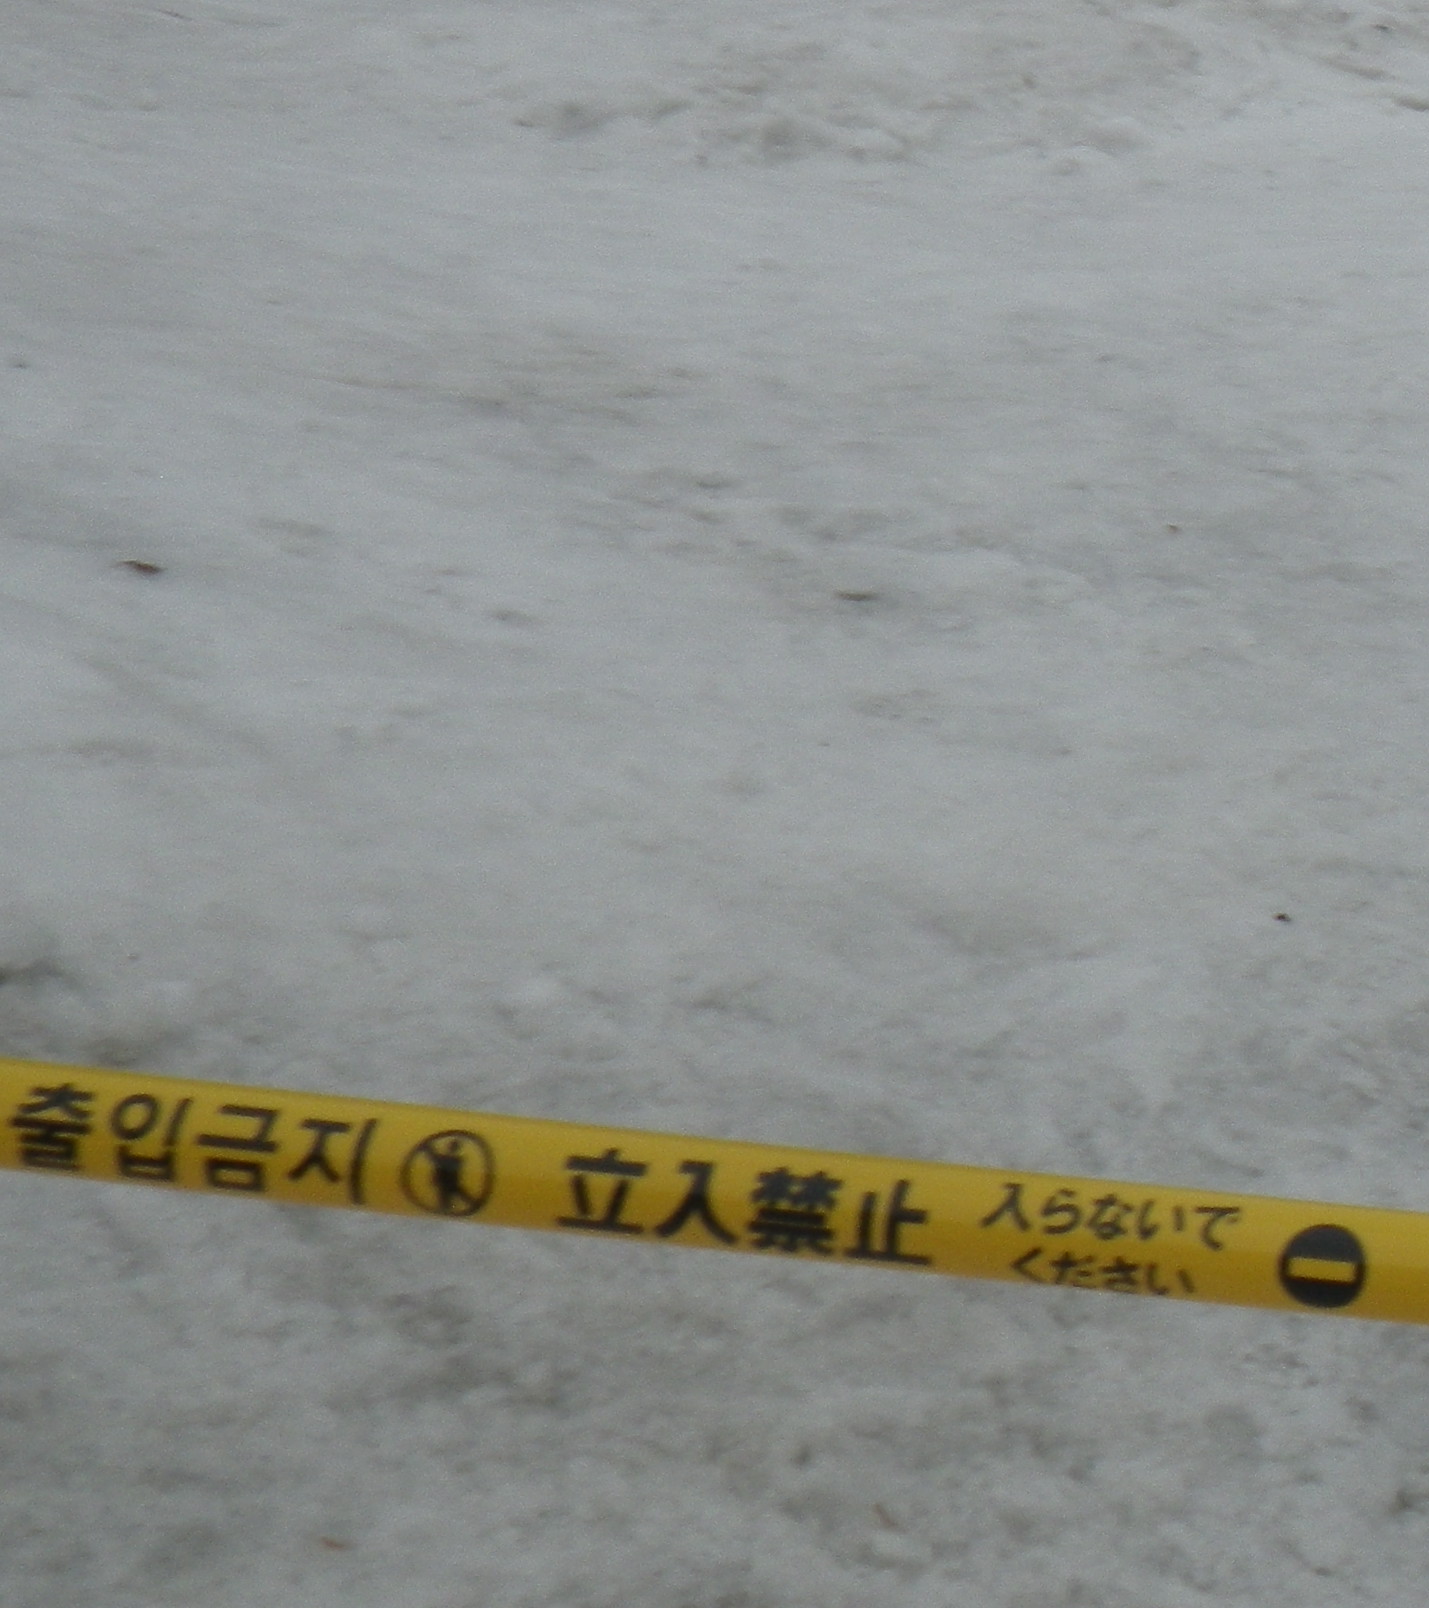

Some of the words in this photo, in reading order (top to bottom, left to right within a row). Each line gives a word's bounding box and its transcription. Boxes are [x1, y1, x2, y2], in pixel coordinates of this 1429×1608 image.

[10, 1083, 378, 1204] 출입금지
[555, 1147, 932, 1267] 立入禁止
[981, 1182, 1242, 1250] 入らないで
[1009, 1246, 1196, 1295] ください
